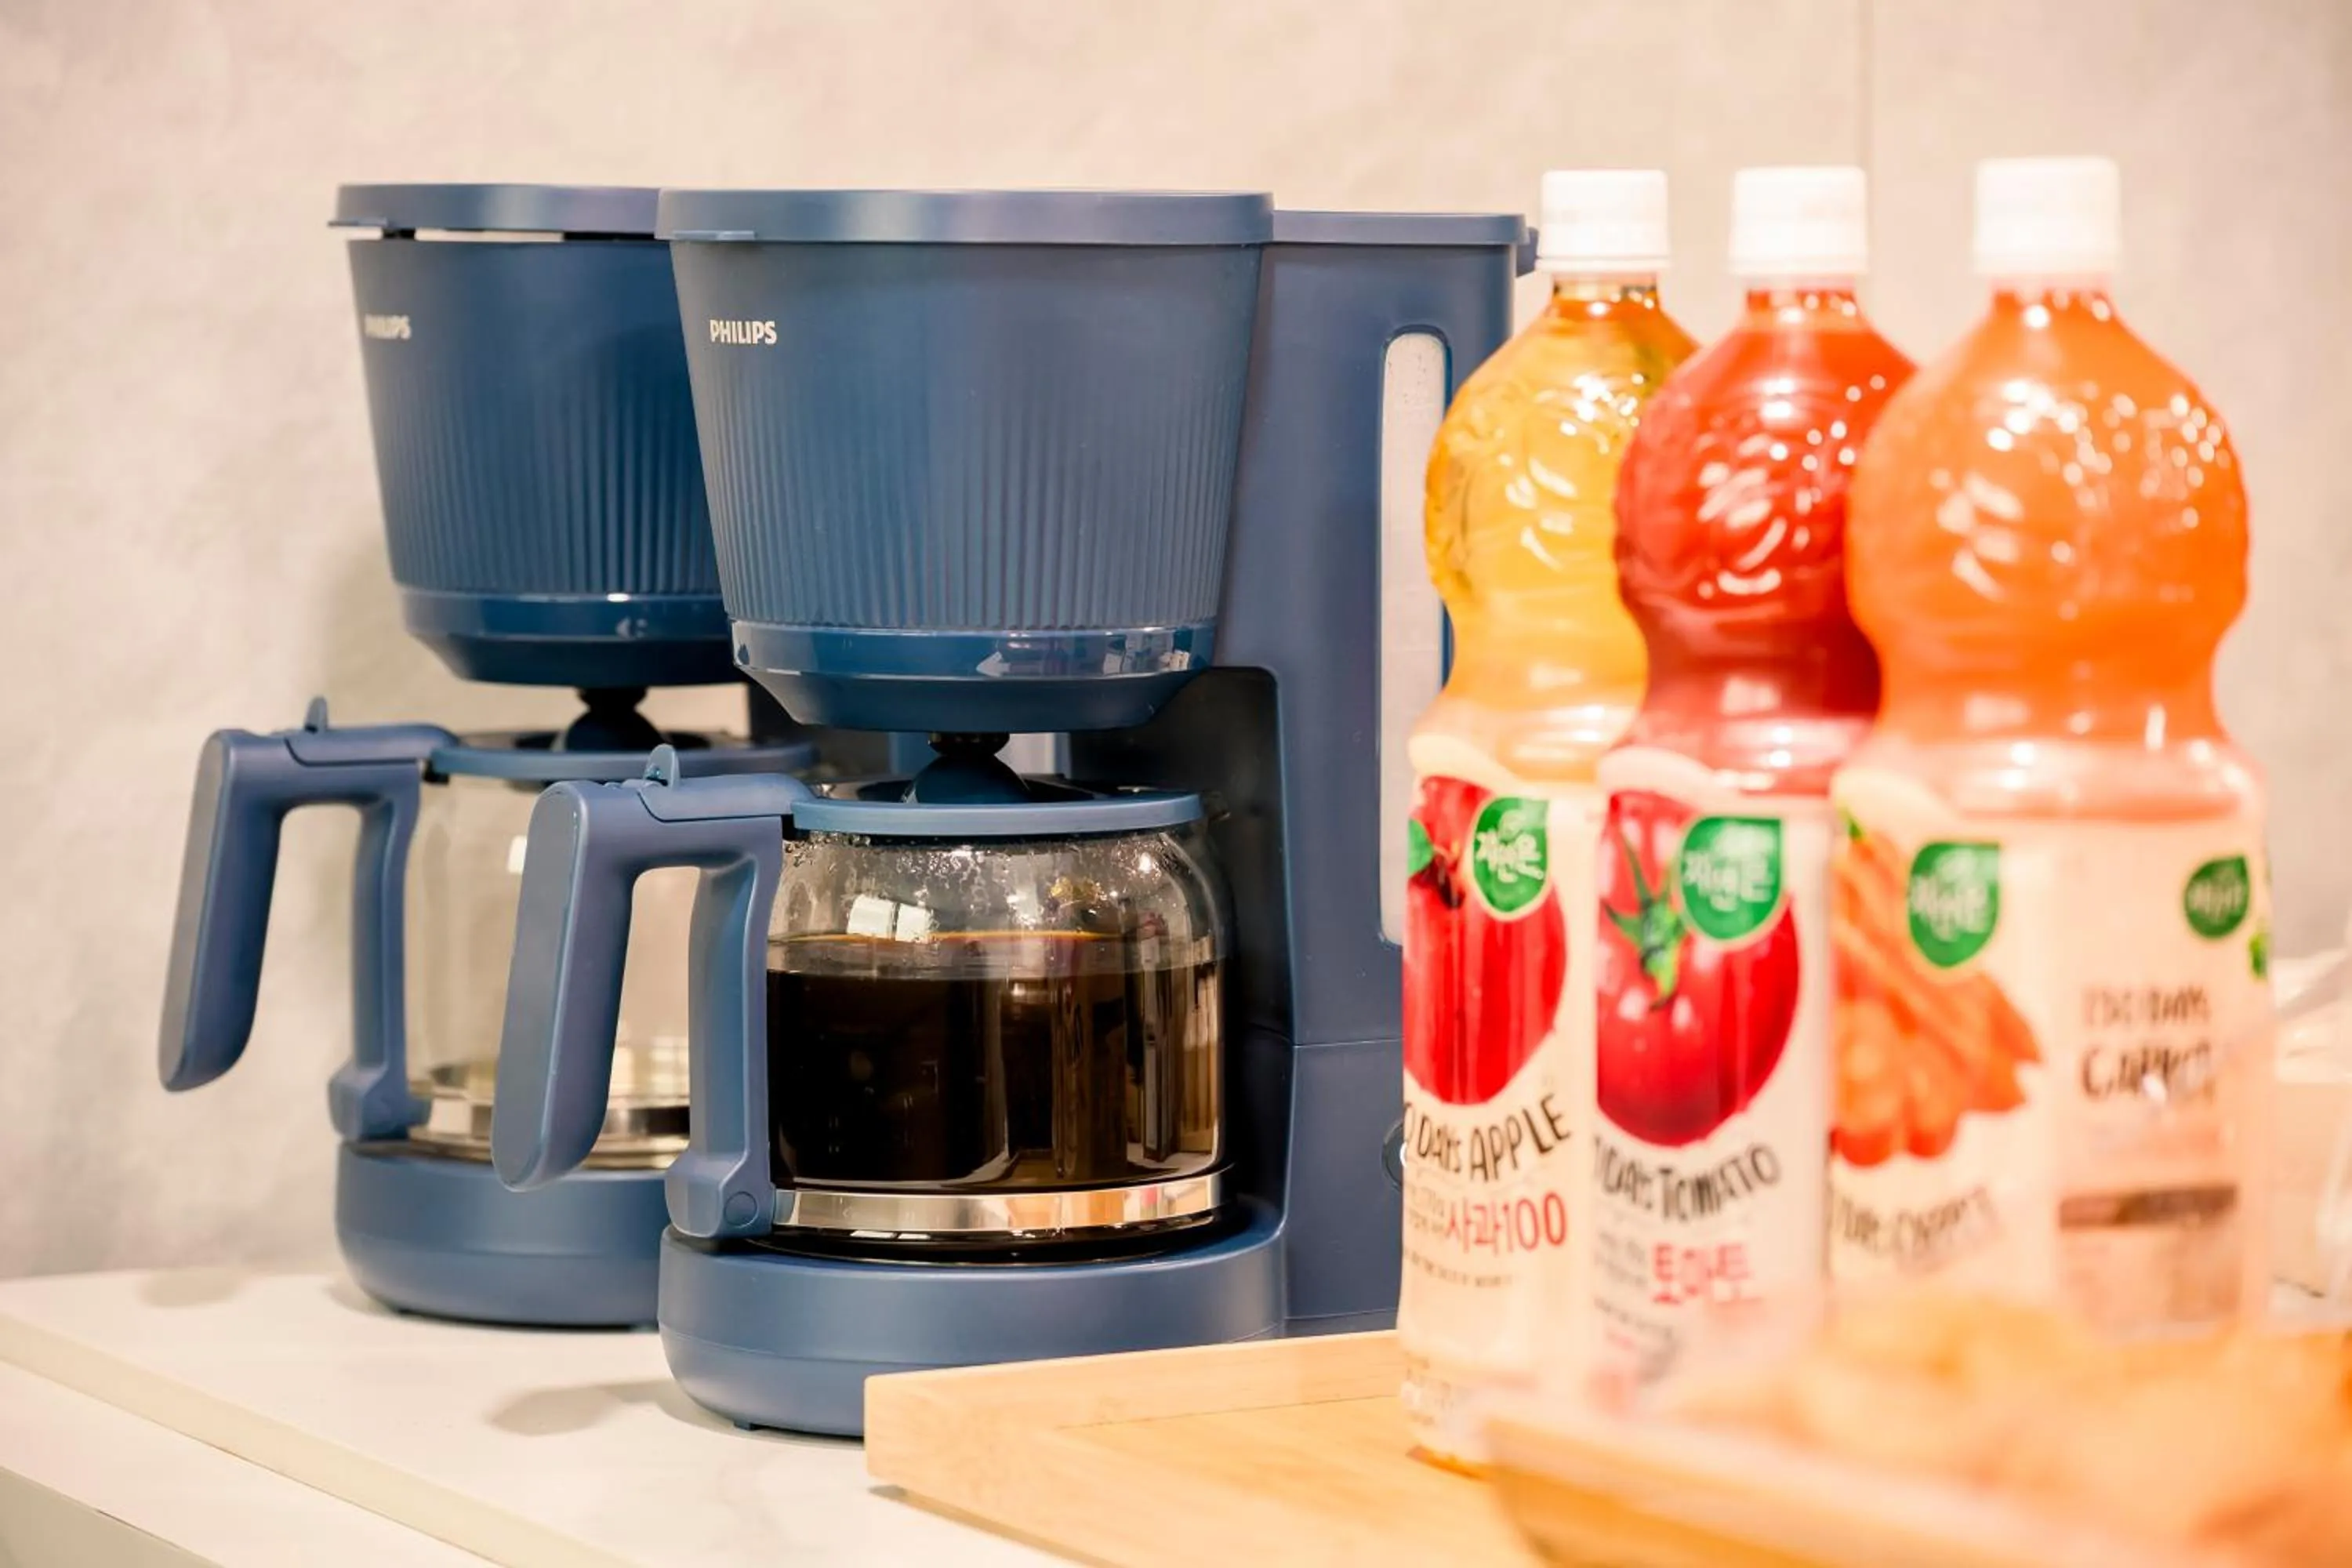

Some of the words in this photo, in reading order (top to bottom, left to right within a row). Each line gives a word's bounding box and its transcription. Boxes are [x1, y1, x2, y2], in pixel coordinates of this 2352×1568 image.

[709, 318, 778, 345] PHILIPS
[1469, 1093, 1571, 1182] APPLE
[1657, 1142, 1782, 1222] TOMATO
